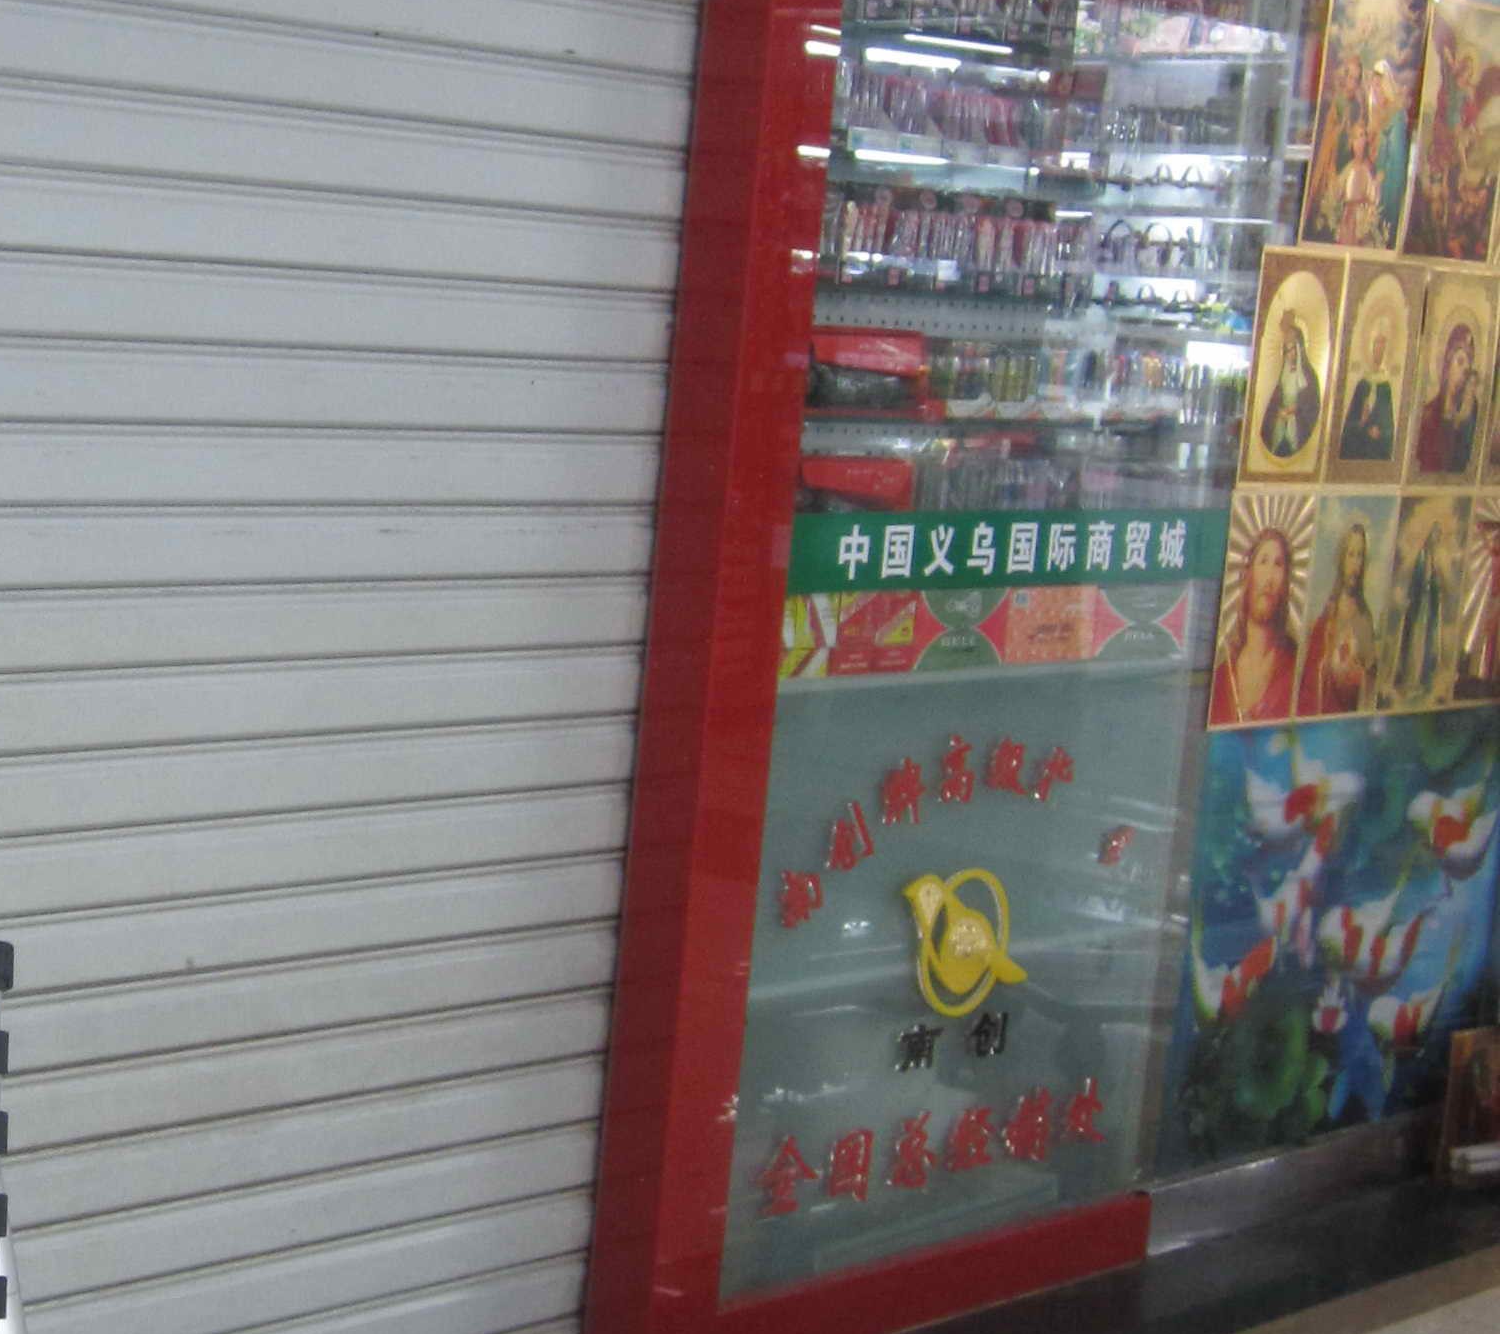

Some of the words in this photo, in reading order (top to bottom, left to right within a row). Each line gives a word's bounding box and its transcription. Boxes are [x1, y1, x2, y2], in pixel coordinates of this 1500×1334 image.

[838, 518, 1187, 581] 中国义乌国际商贸城
